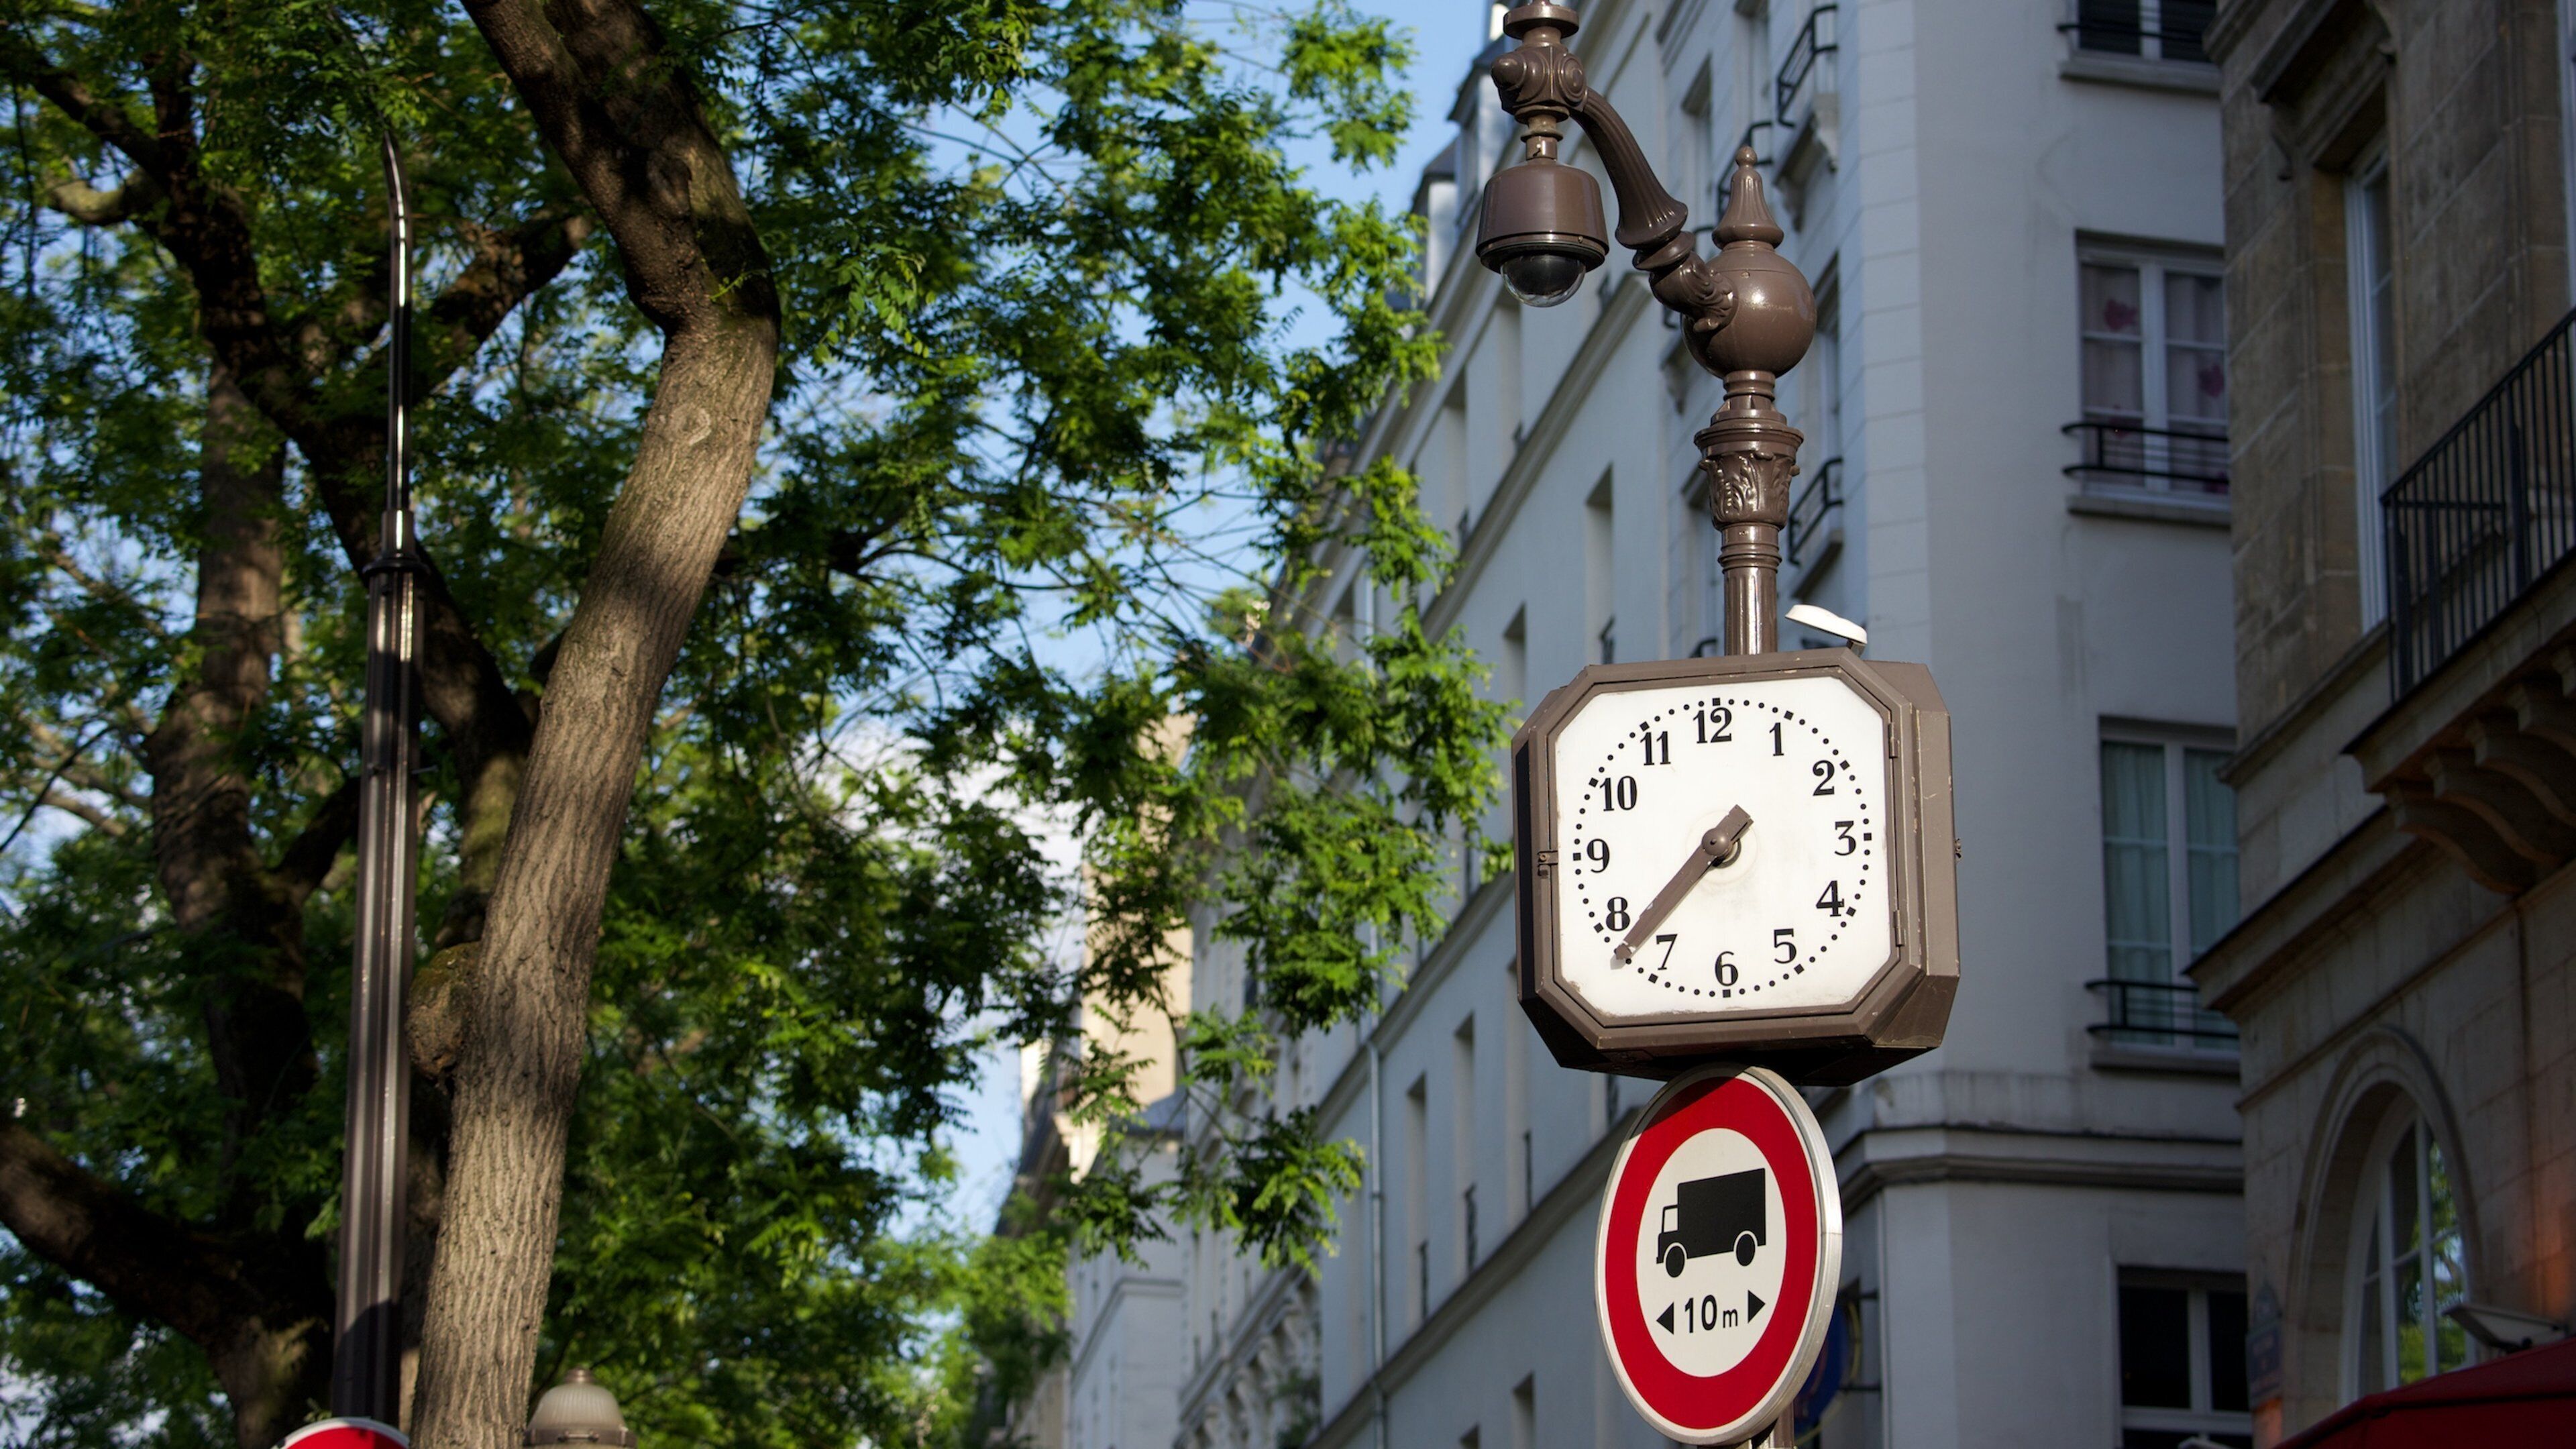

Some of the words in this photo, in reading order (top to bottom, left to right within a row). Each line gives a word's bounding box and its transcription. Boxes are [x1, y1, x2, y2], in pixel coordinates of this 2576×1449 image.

[1693, 707, 1732, 744] 12
[1769, 722, 1784, 757] 1
[1640, 731, 1671, 766] 11
[1599, 775, 1638, 812] 10
[1812, 759, 1835, 796] 2
[1587, 839, 1610, 873] 9
[1834, 820, 1857, 856] 3
[1605, 896, 1631, 932] 8
[1815, 880, 1845, 917] 4
[1656, 933, 1678, 971] 7
[1774, 928, 1797, 964] 5
[1715, 951, 1739, 987] 6
